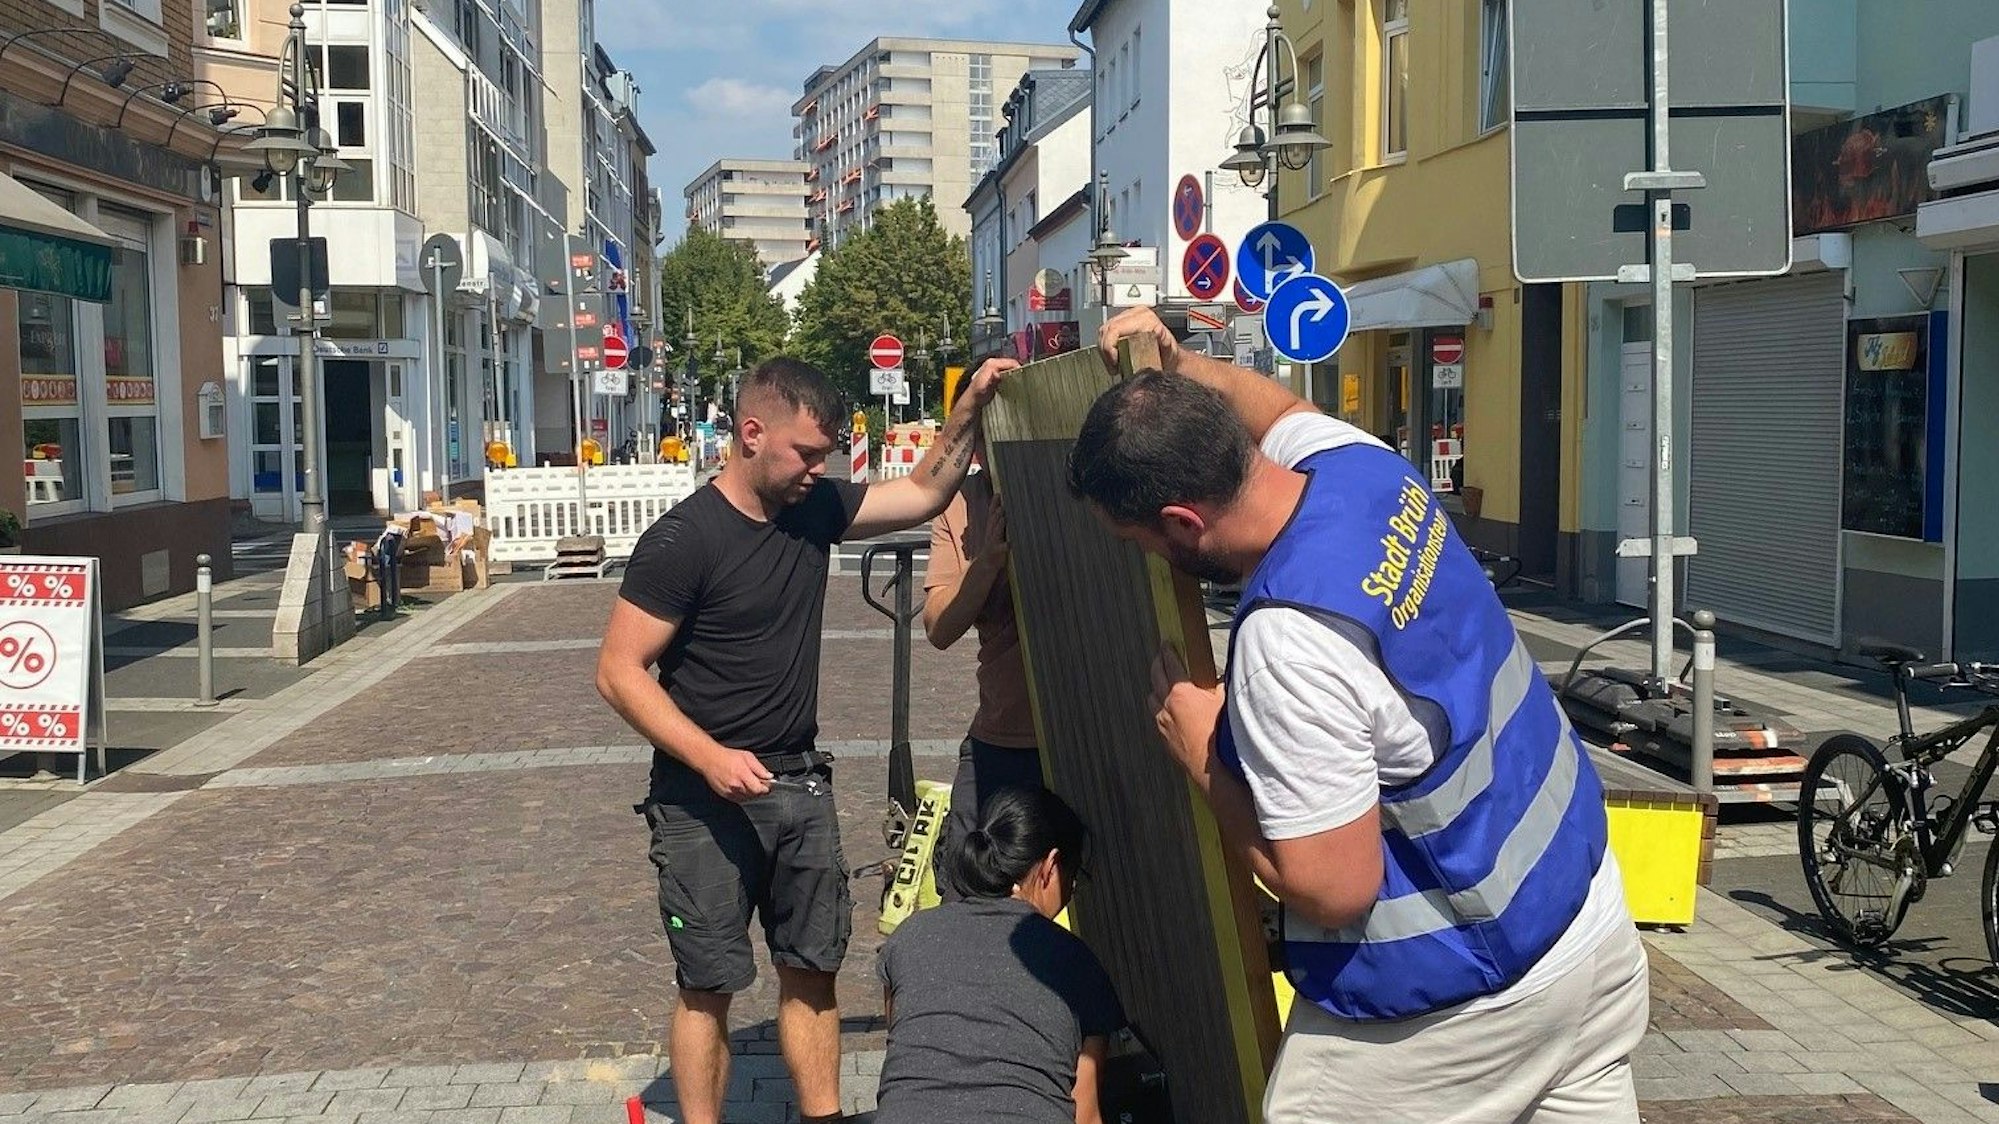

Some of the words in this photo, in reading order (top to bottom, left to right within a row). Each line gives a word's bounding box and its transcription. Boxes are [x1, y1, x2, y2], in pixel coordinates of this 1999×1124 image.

[209, 306, 220, 322] 37
[352, 345, 373, 354] Bank
[1361, 533, 1411, 606] Stadt
[1388, 475, 1429, 544] Brühl
[7, 574, 36, 598] %
[44, 575, 73, 599] %
[0, 636, 45, 674] %
[1, 713, 30, 737] %
[37, 713, 66, 738] %
